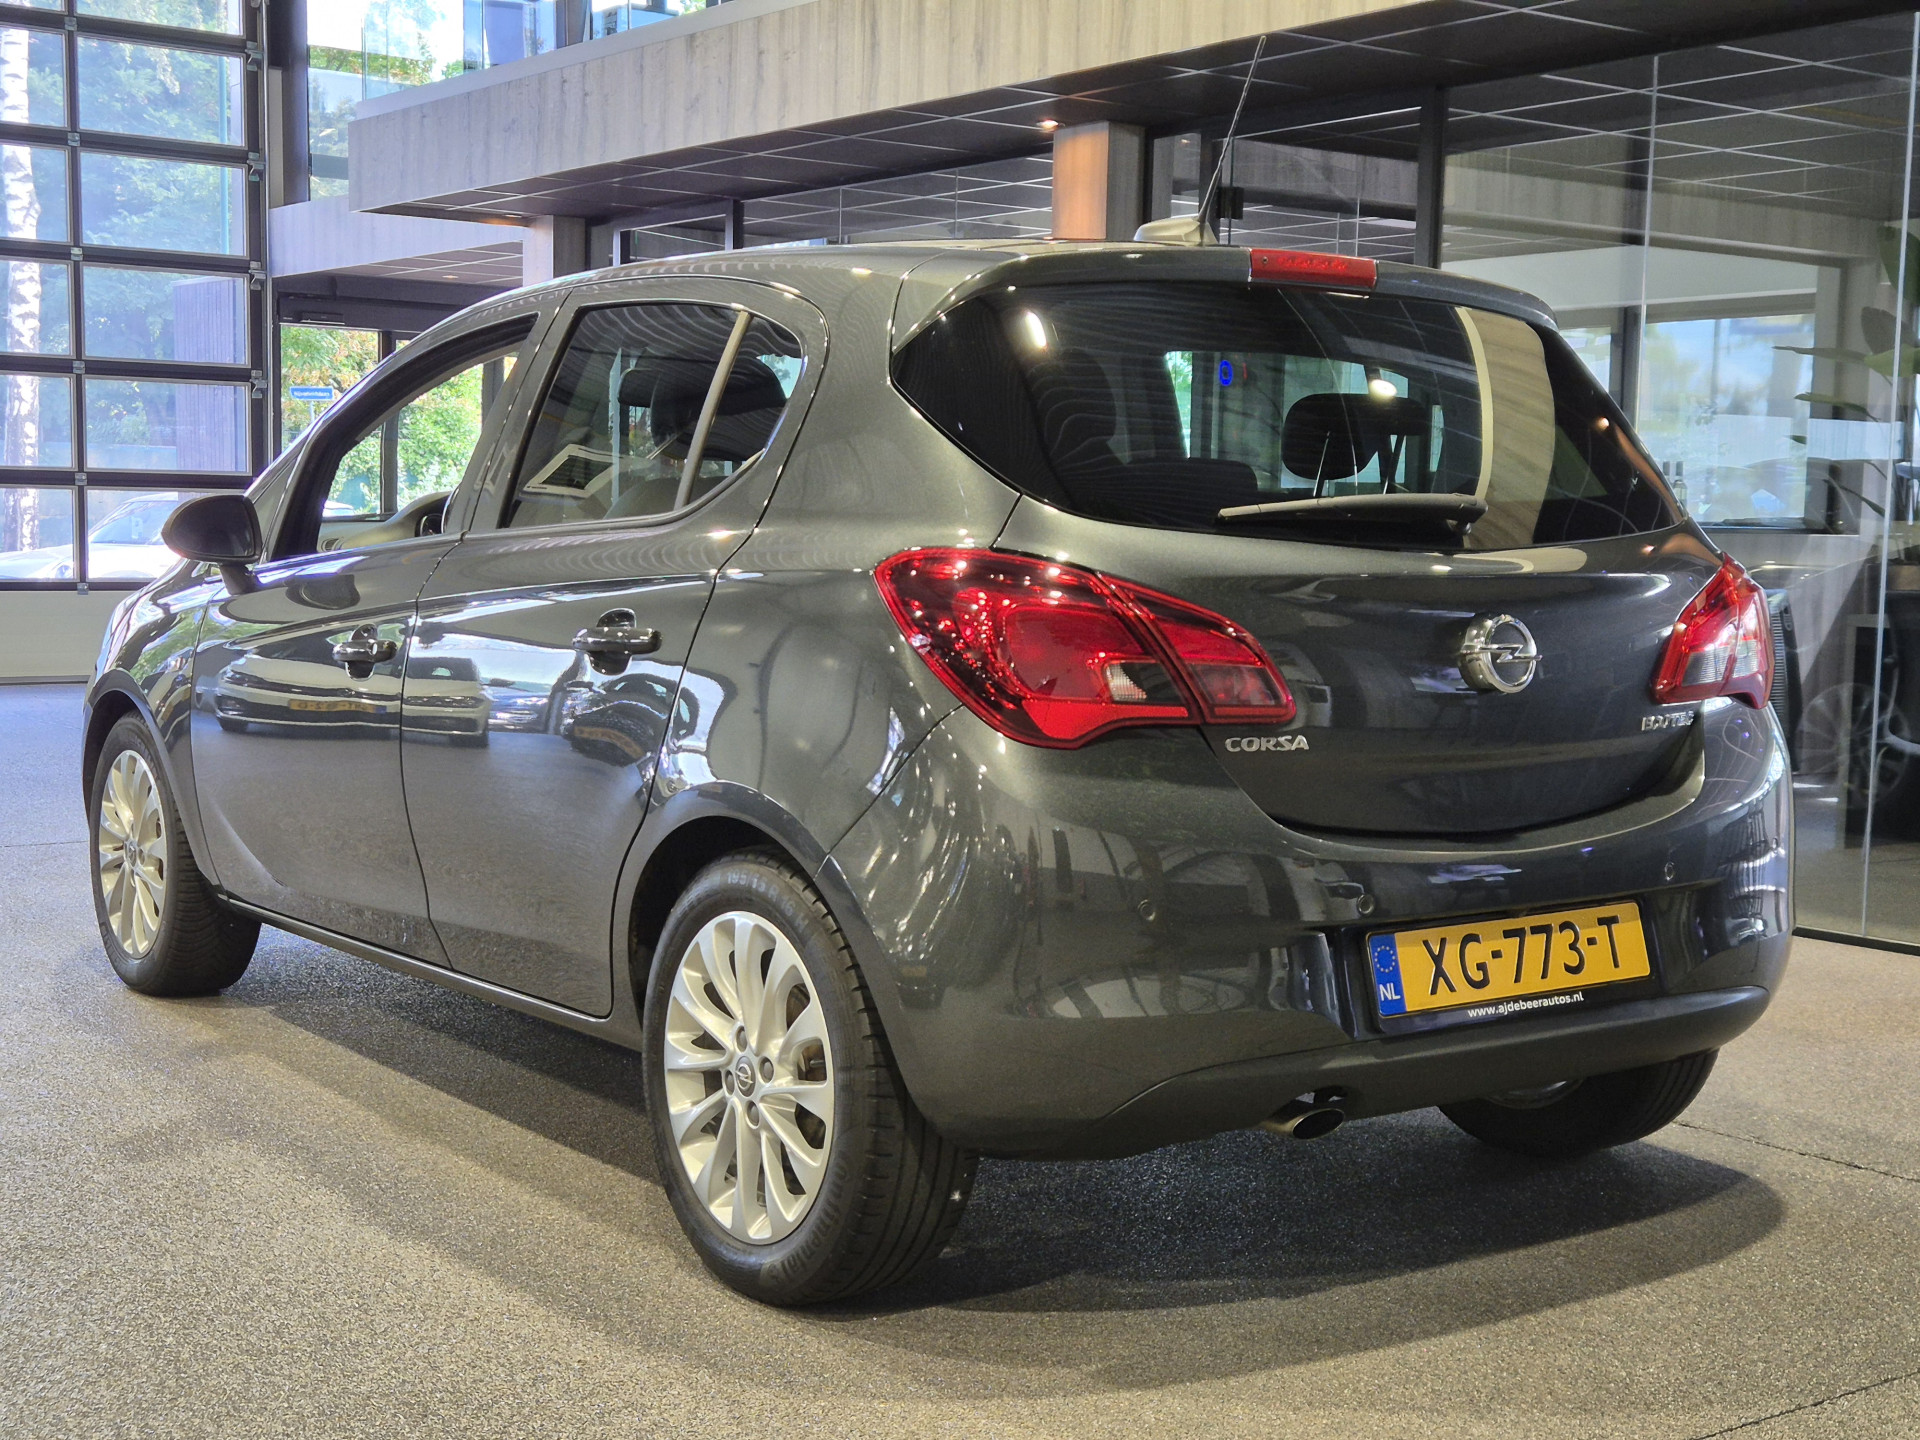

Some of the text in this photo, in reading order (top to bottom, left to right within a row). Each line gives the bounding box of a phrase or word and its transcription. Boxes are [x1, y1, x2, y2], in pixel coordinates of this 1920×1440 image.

[1225, 735, 1309, 752] CORSA
[1422, 914, 1620, 996] XG-773-T
[1379, 982, 1401, 1001] NL
[1467, 991, 1585, 1016] www.ajdebeerautos.nl
